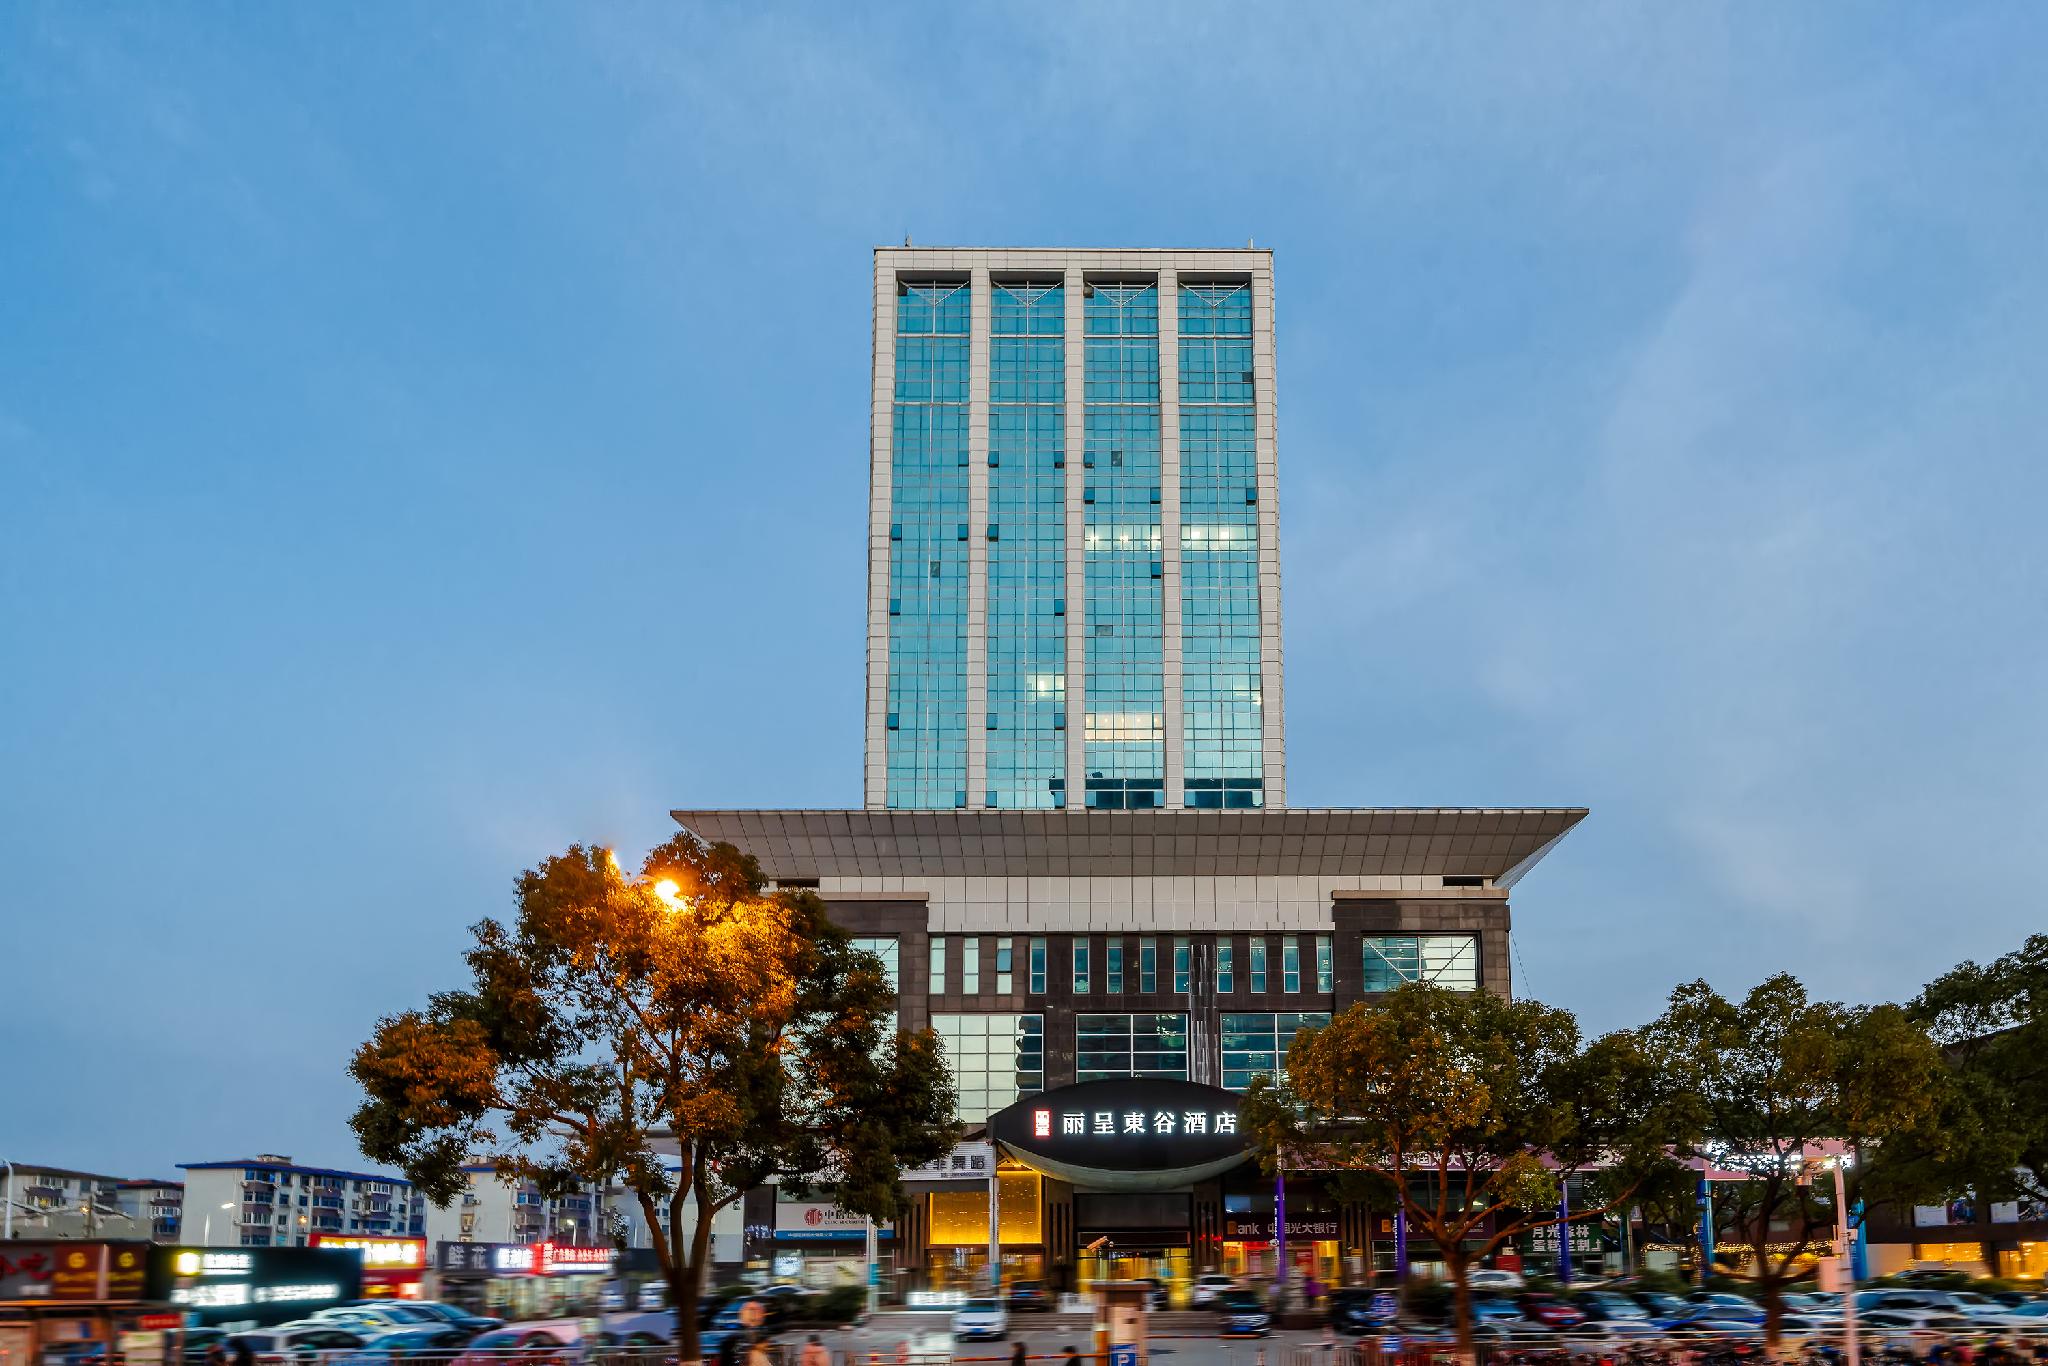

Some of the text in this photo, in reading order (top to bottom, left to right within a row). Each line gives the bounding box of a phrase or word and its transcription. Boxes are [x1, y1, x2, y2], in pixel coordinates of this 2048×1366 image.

[1062, 1111, 1237, 1134] 丽呈東谷酒店
[1227, 1220, 1259, 1235] Bank
